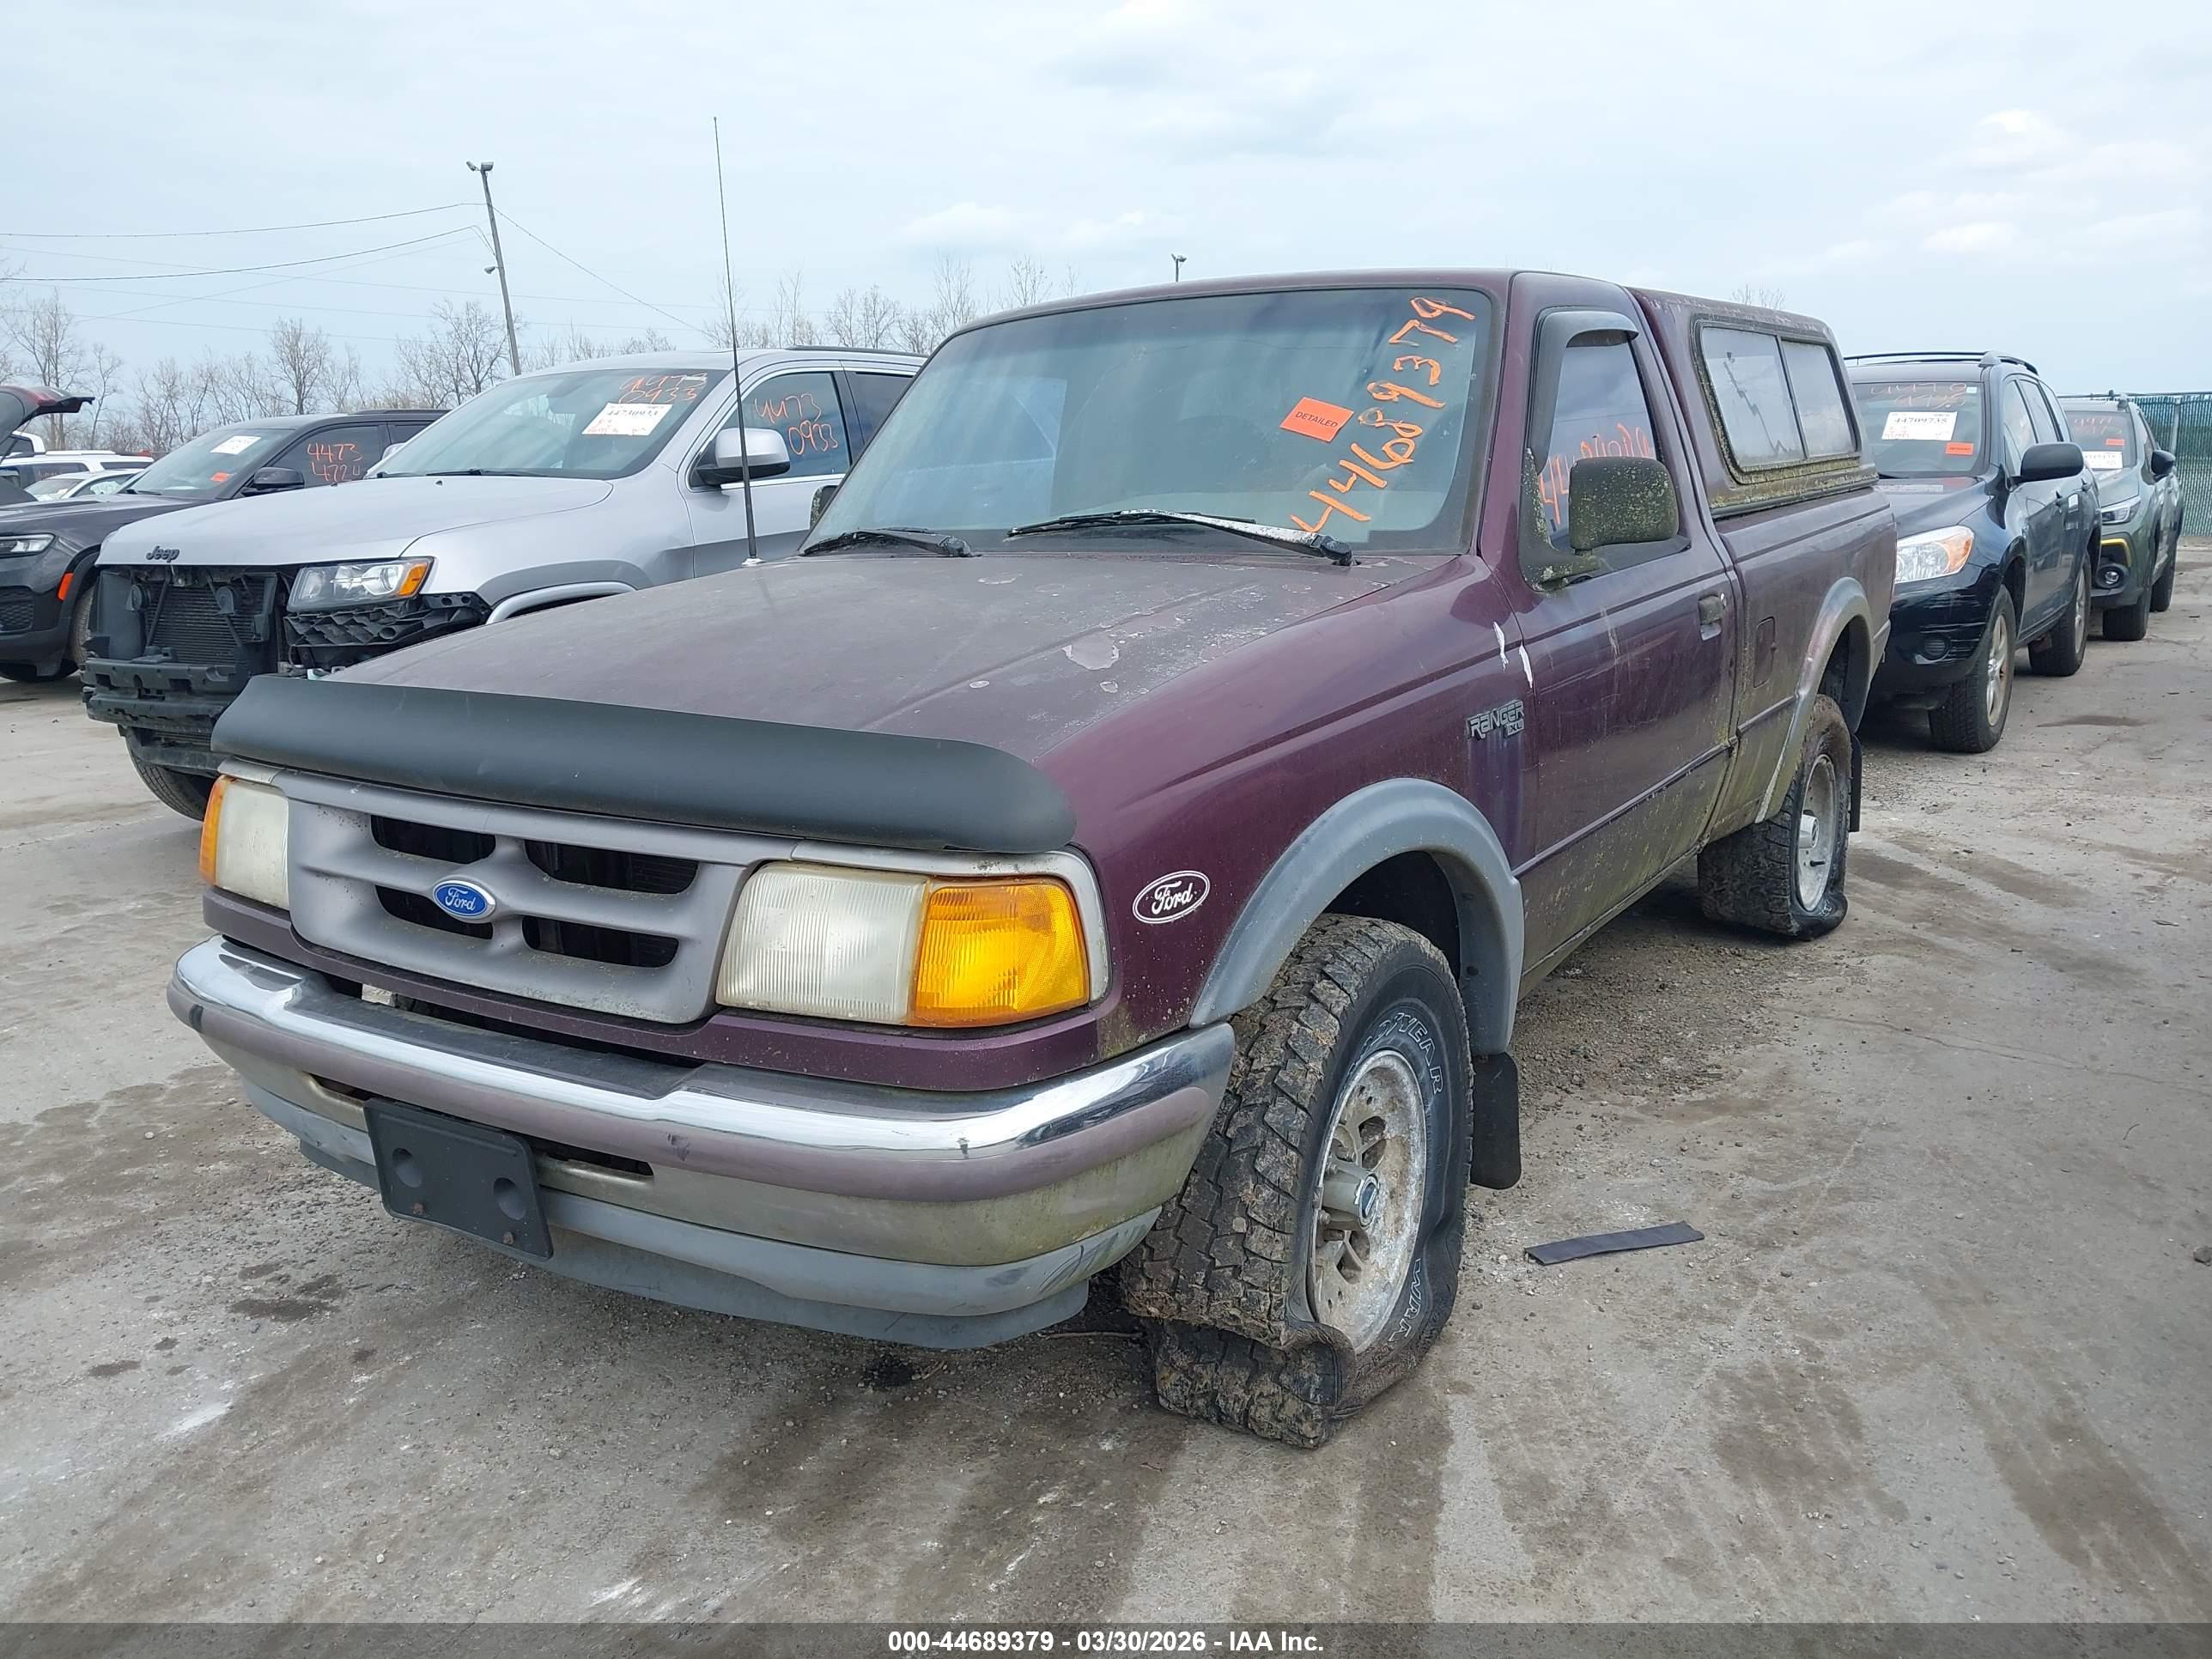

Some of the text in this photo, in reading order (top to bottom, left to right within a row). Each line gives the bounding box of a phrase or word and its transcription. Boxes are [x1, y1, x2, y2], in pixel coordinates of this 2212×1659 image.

[754, 392, 823, 424] 4473
[1291, 298, 1475, 532] 44689379
[1295, 411, 1339, 428] DETAILED
[787, 419, 839, 455] 0933
[307, 441, 363, 464] 4473
[146, 545, 180, 563] Jeep
[445, 887, 477, 911] Ford
[1151, 880, 1194, 915] Ford
